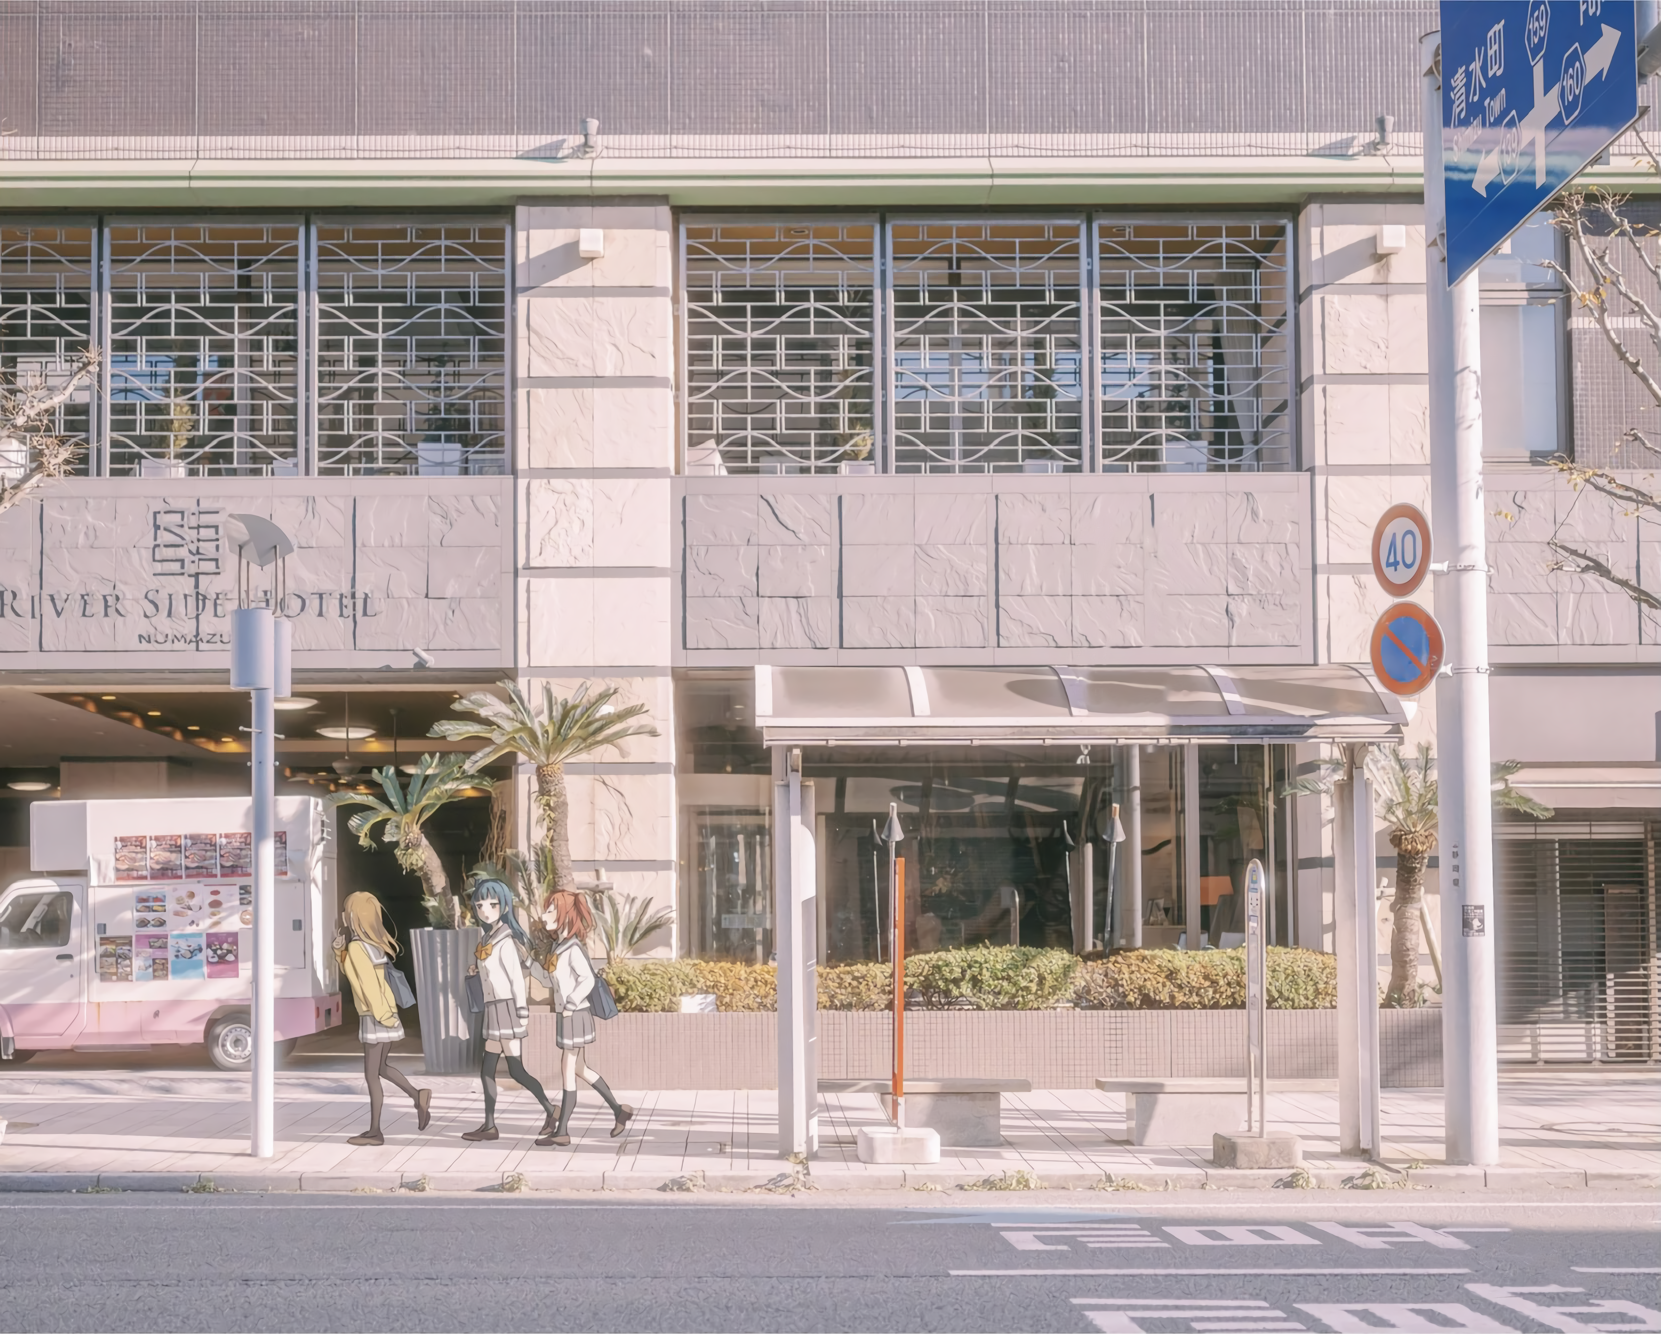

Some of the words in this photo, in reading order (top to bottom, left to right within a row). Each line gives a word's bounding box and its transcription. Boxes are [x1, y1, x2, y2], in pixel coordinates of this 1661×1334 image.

[1530, 4, 1546, 48] 159
[1450, 19, 1505, 128] 清水町
[1562, 61, 1582, 106] 160
[1484, 88, 1506, 128] Town
[1385, 529, 1417, 572] 40
[0, 589, 128, 618] RIVER
[143, 589, 228, 619] SIDE
[138, 632, 232, 645] NUMAZU
